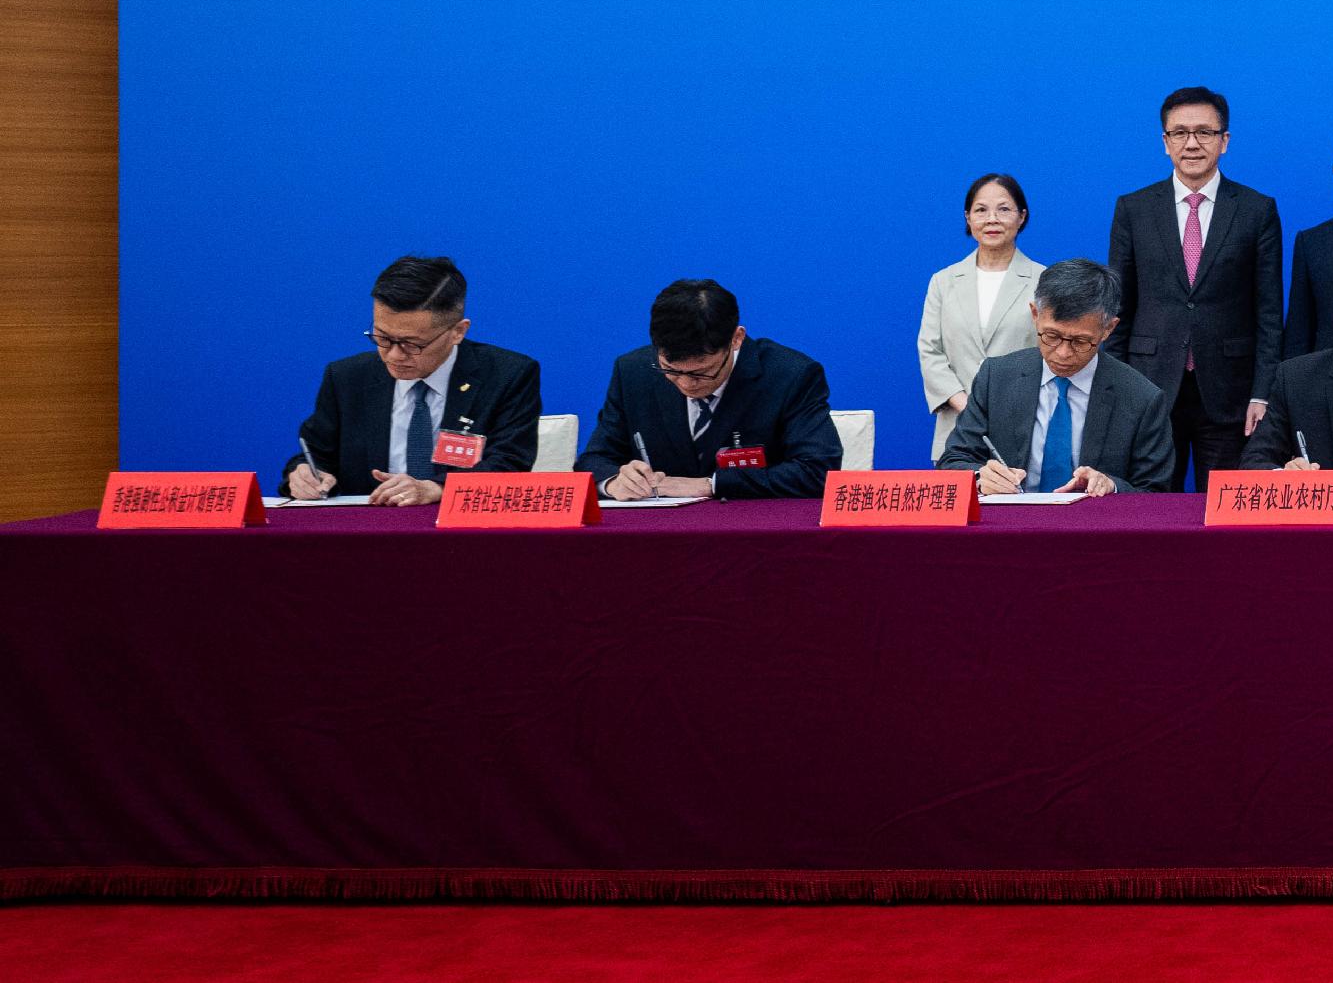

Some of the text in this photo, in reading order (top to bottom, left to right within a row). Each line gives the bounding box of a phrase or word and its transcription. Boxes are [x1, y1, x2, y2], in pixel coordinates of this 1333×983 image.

[449, 485, 576, 514] 广东省社会保险基金管理局
[833, 483, 958, 512] 香港渔农自然护理署
